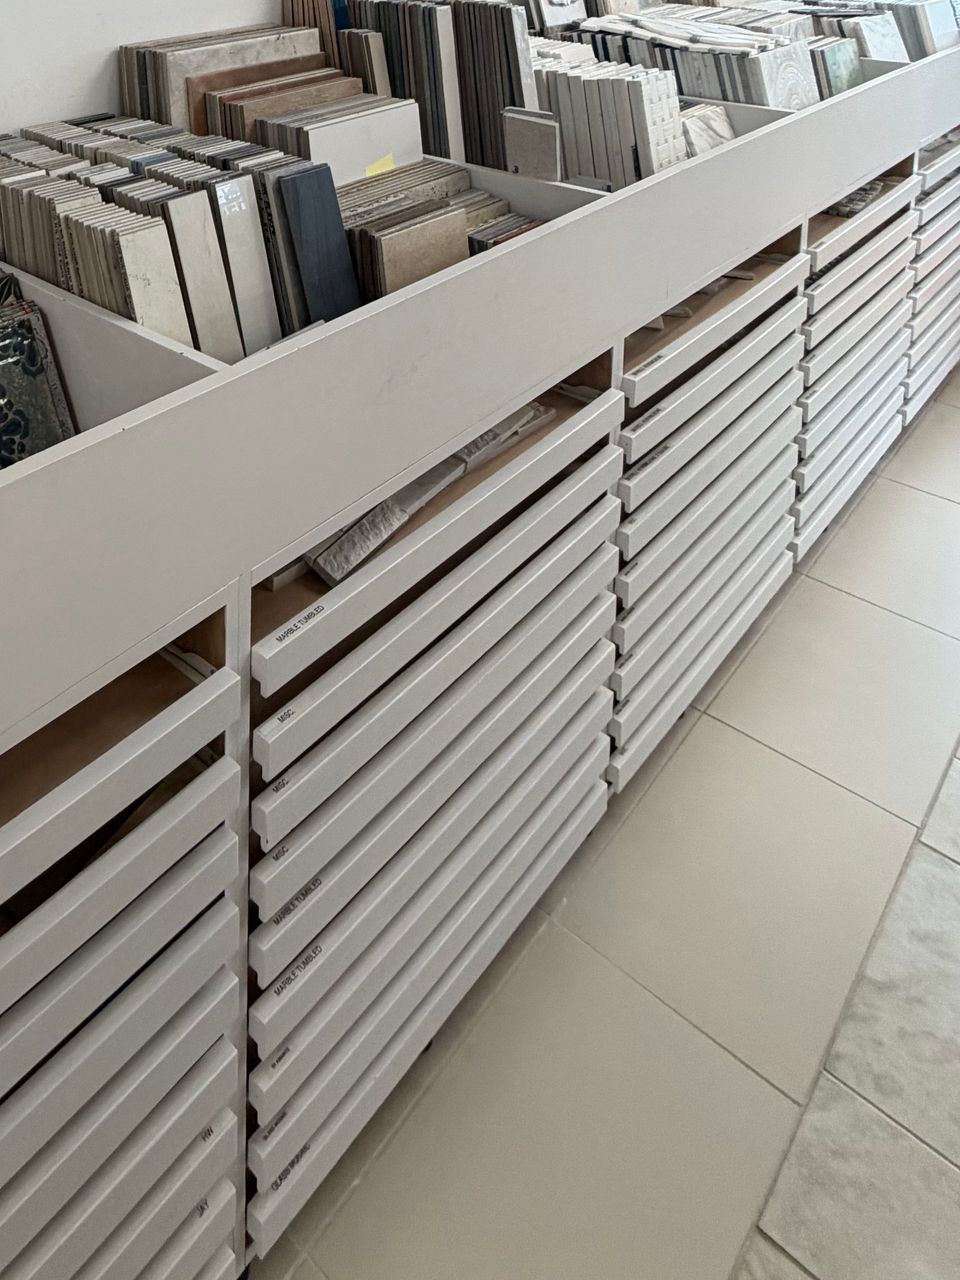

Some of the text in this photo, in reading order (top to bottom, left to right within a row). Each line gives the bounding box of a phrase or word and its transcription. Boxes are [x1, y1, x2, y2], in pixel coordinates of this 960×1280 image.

[275, 605, 325, 643] MARBLE TUMBLED
[272, 877, 322, 925] MARBLE TUMBLED
[273, 945, 323, 997] MARBLE TUMBLED
